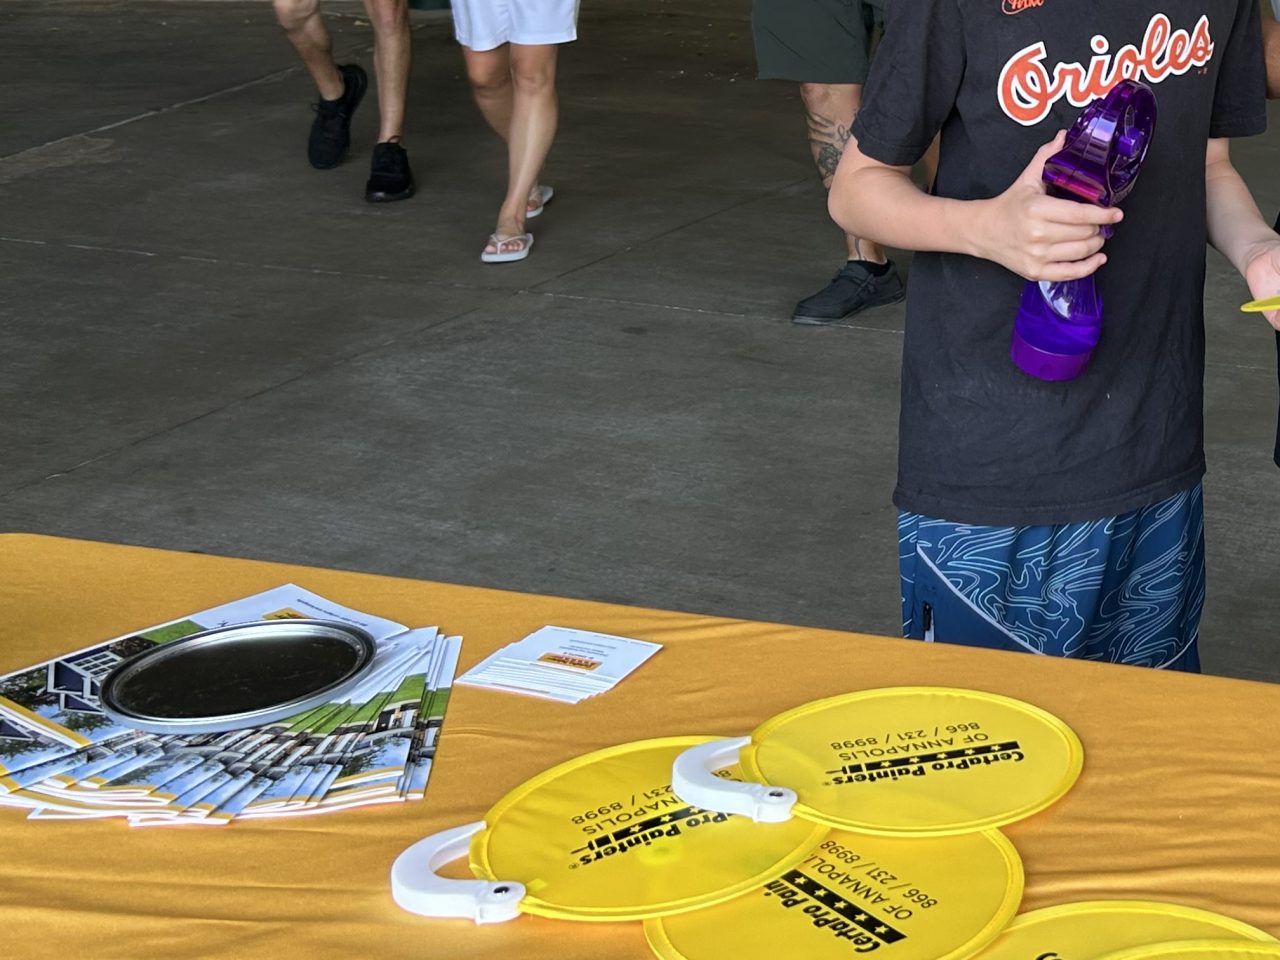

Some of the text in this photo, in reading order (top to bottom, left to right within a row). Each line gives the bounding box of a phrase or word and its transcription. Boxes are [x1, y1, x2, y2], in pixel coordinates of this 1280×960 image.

[997, 13, 1214, 126] Orioles
[897, 730, 927, 740] 231
[946, 722, 980, 733] 866
[831, 737, 878, 750] 8998
[839, 733, 988, 761] OF ANNAPOLIS
[931, 751, 1024, 771] CertaPro
[571, 801, 623, 825] 8998
[582, 795, 684, 835] NAPOLIS
[820, 840, 860, 864] 8998
[803, 852, 913, 920] OF ANNAPOLI
[866, 867, 897, 884] 231
[902, 888, 938, 908] 866
[803, 904, 881, 953] CertaPro
